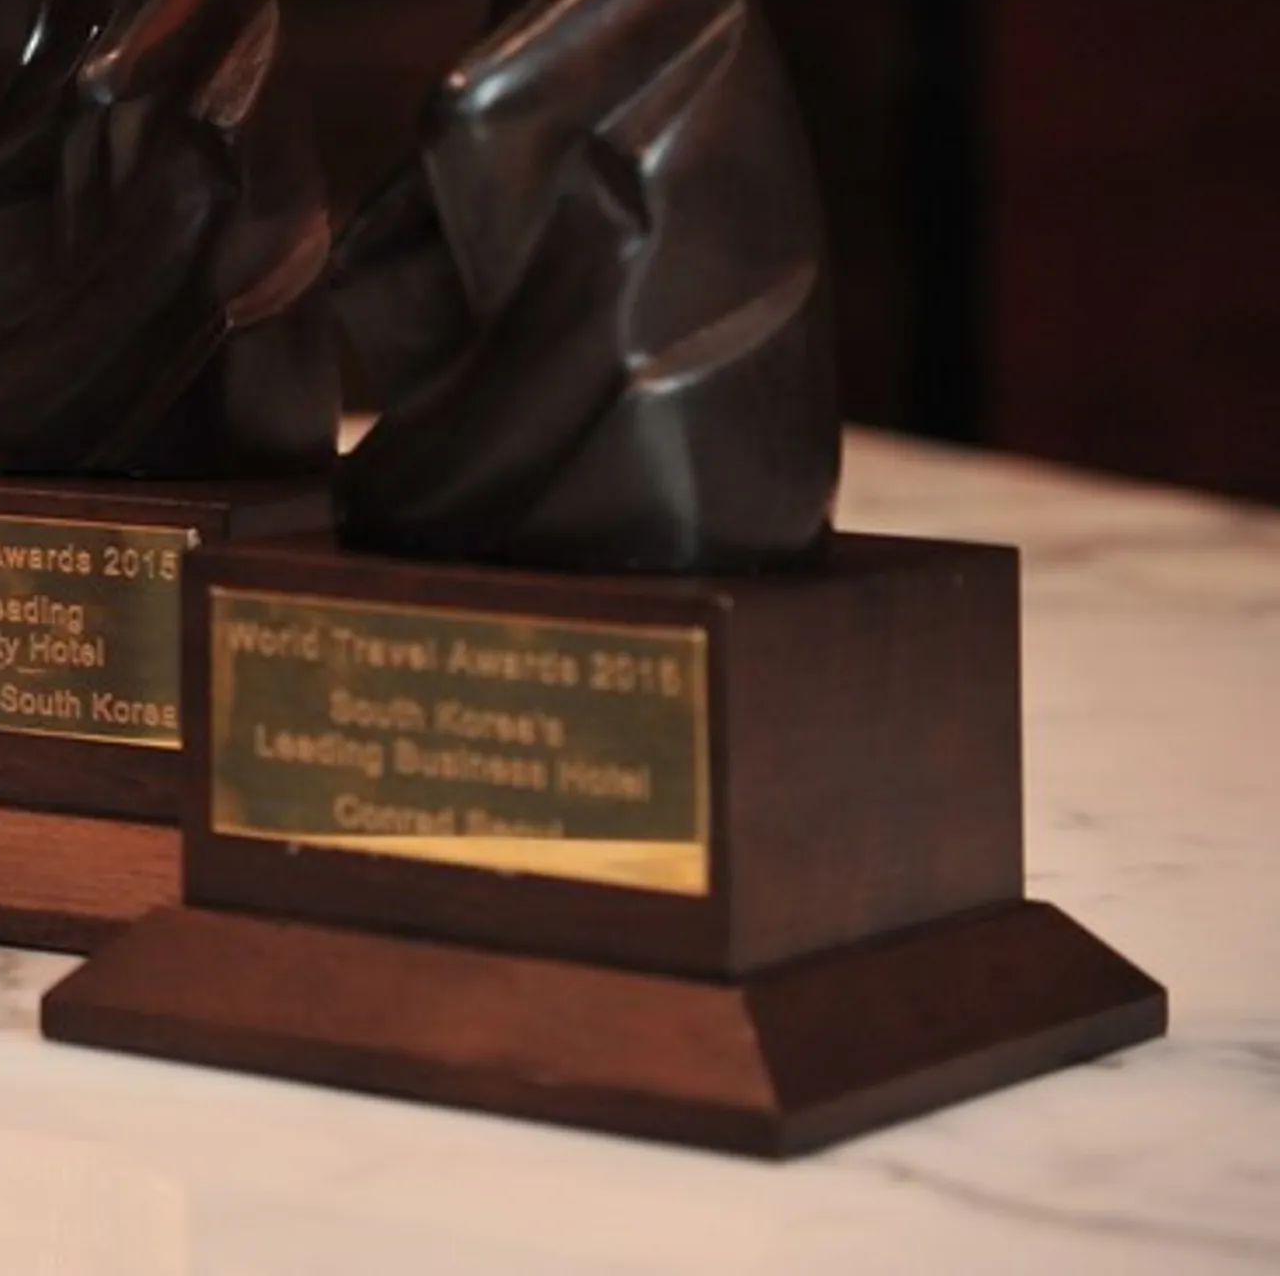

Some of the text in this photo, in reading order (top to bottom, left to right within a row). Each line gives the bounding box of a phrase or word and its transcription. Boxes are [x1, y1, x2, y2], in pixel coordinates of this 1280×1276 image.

[103, 547, 178, 581] 2015
[29, 634, 105, 669] Hotel
[227, 621, 681, 698] World Travel Awards 2015
[0, 683, 81, 720] South
[91, 691, 177, 728] Korea
[329, 688, 565, 749] South Korea's
[255, 725, 651, 803] Leading Business Hotel
[333, 792, 455, 834] Conrad
